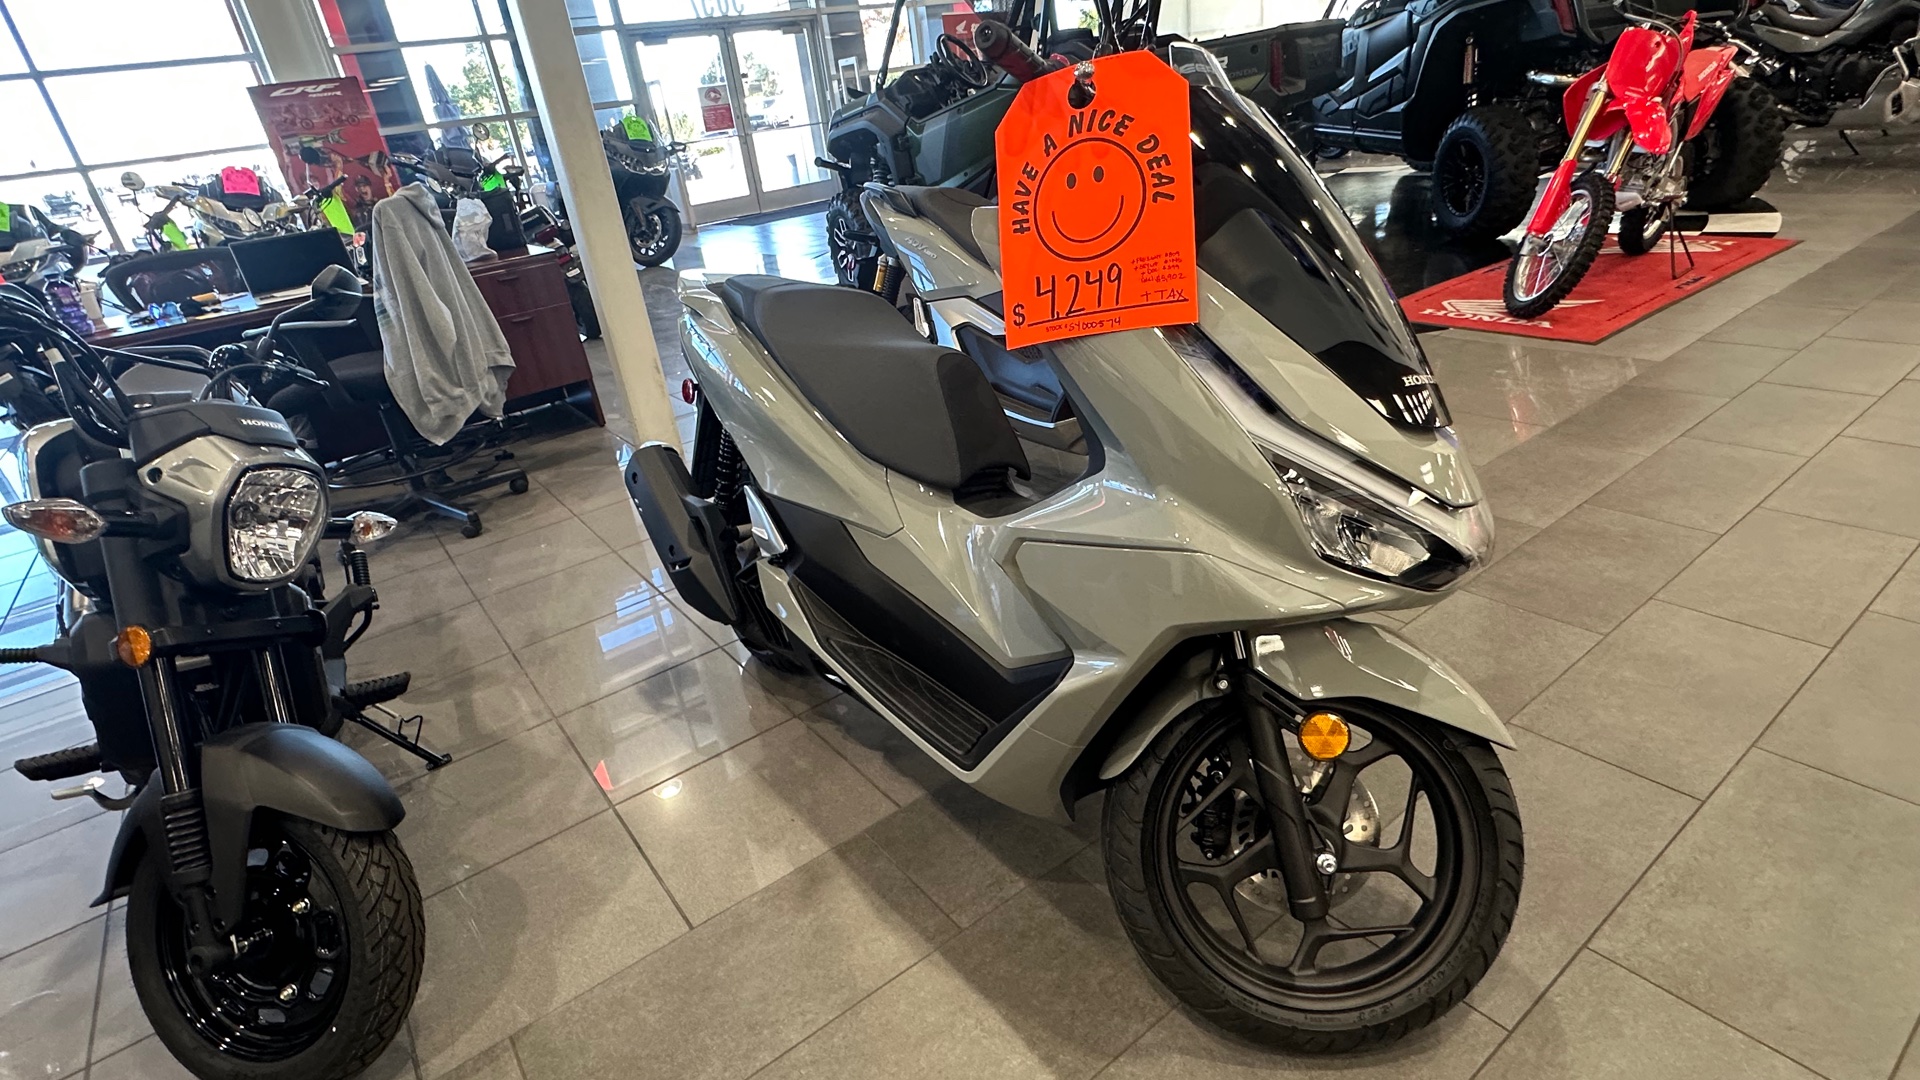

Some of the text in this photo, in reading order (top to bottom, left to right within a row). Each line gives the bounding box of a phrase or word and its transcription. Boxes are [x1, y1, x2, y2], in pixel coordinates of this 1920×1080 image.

[269, 82, 341, 98] CRF
[1012, 109, 1176, 234] HAVE A NICE DEAL
[1153, 287, 1187, 301] TAX
[1012, 302, 1026, 329] $
[1418, 308, 1554, 329] HONDA
[240, 419, 290, 432] HONDA
